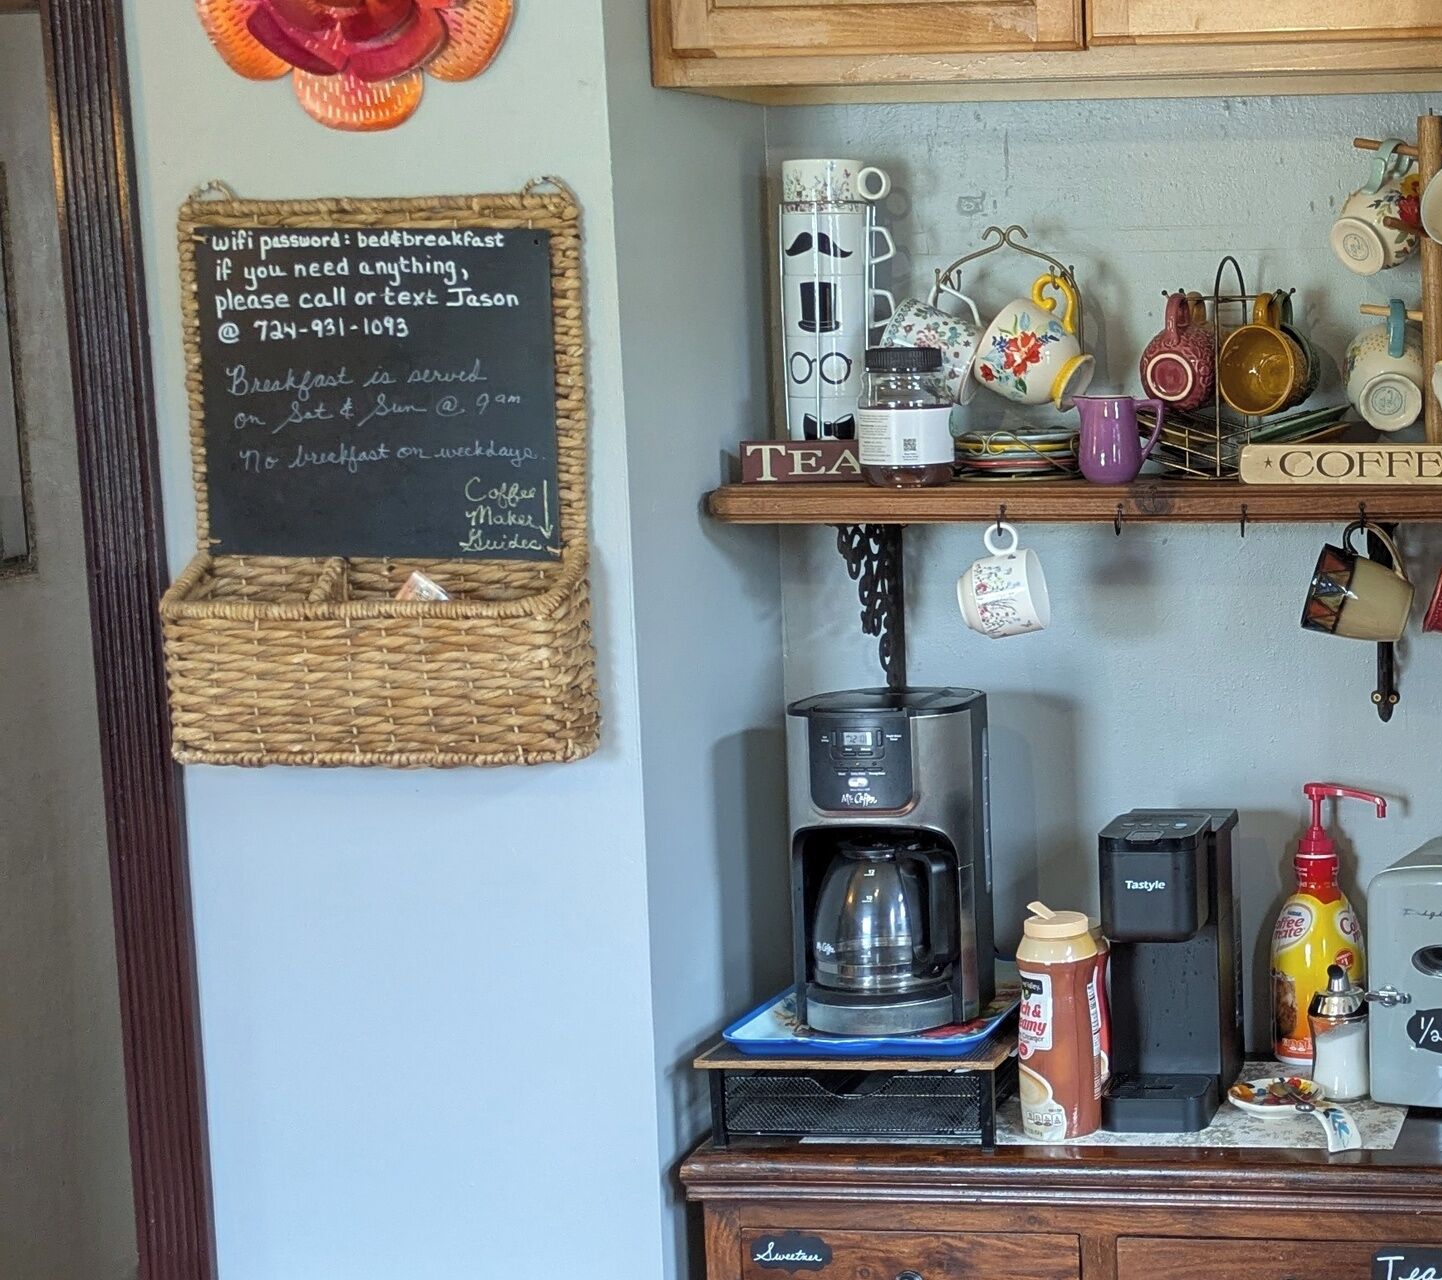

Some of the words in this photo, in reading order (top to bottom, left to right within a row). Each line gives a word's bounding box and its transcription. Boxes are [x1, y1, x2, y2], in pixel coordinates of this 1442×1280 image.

[212, 230, 253, 251] wifi
[216, 258, 232, 281] if
[244, 264, 287, 290] you
[294, 257, 349, 278] need
[359, 255, 469, 286] anything,
[215, 288, 290, 319] please
[299, 286, 347, 308] call
[354, 291, 376, 305] or
[380, 286, 439, 306] text
[445, 287, 520, 307] Jason
[218, 322, 240, 344] @
[253, 316, 409, 341] 724-931-1093
[225, 364, 354, 401] Breakfast
[363, 365, 397, 387] is
[407, 358, 487, 383] served
[234, 412, 266, 429] on
[272, 401, 334, 434] Sat
[339, 397, 354, 419] &
[357, 393, 427, 427] Sun
[436, 395, 465, 417] @
[240, 450, 279, 473] No
[288, 443, 390, 473] breakfast
[397, 446, 432, 459] on
[746, 445, 862, 481] TEA
[465, 476, 536, 509] Coffee
[465, 505, 540, 529] Maker
[459, 528, 542, 552] Guides
[1125, 880, 1166, 891] Tastyle
